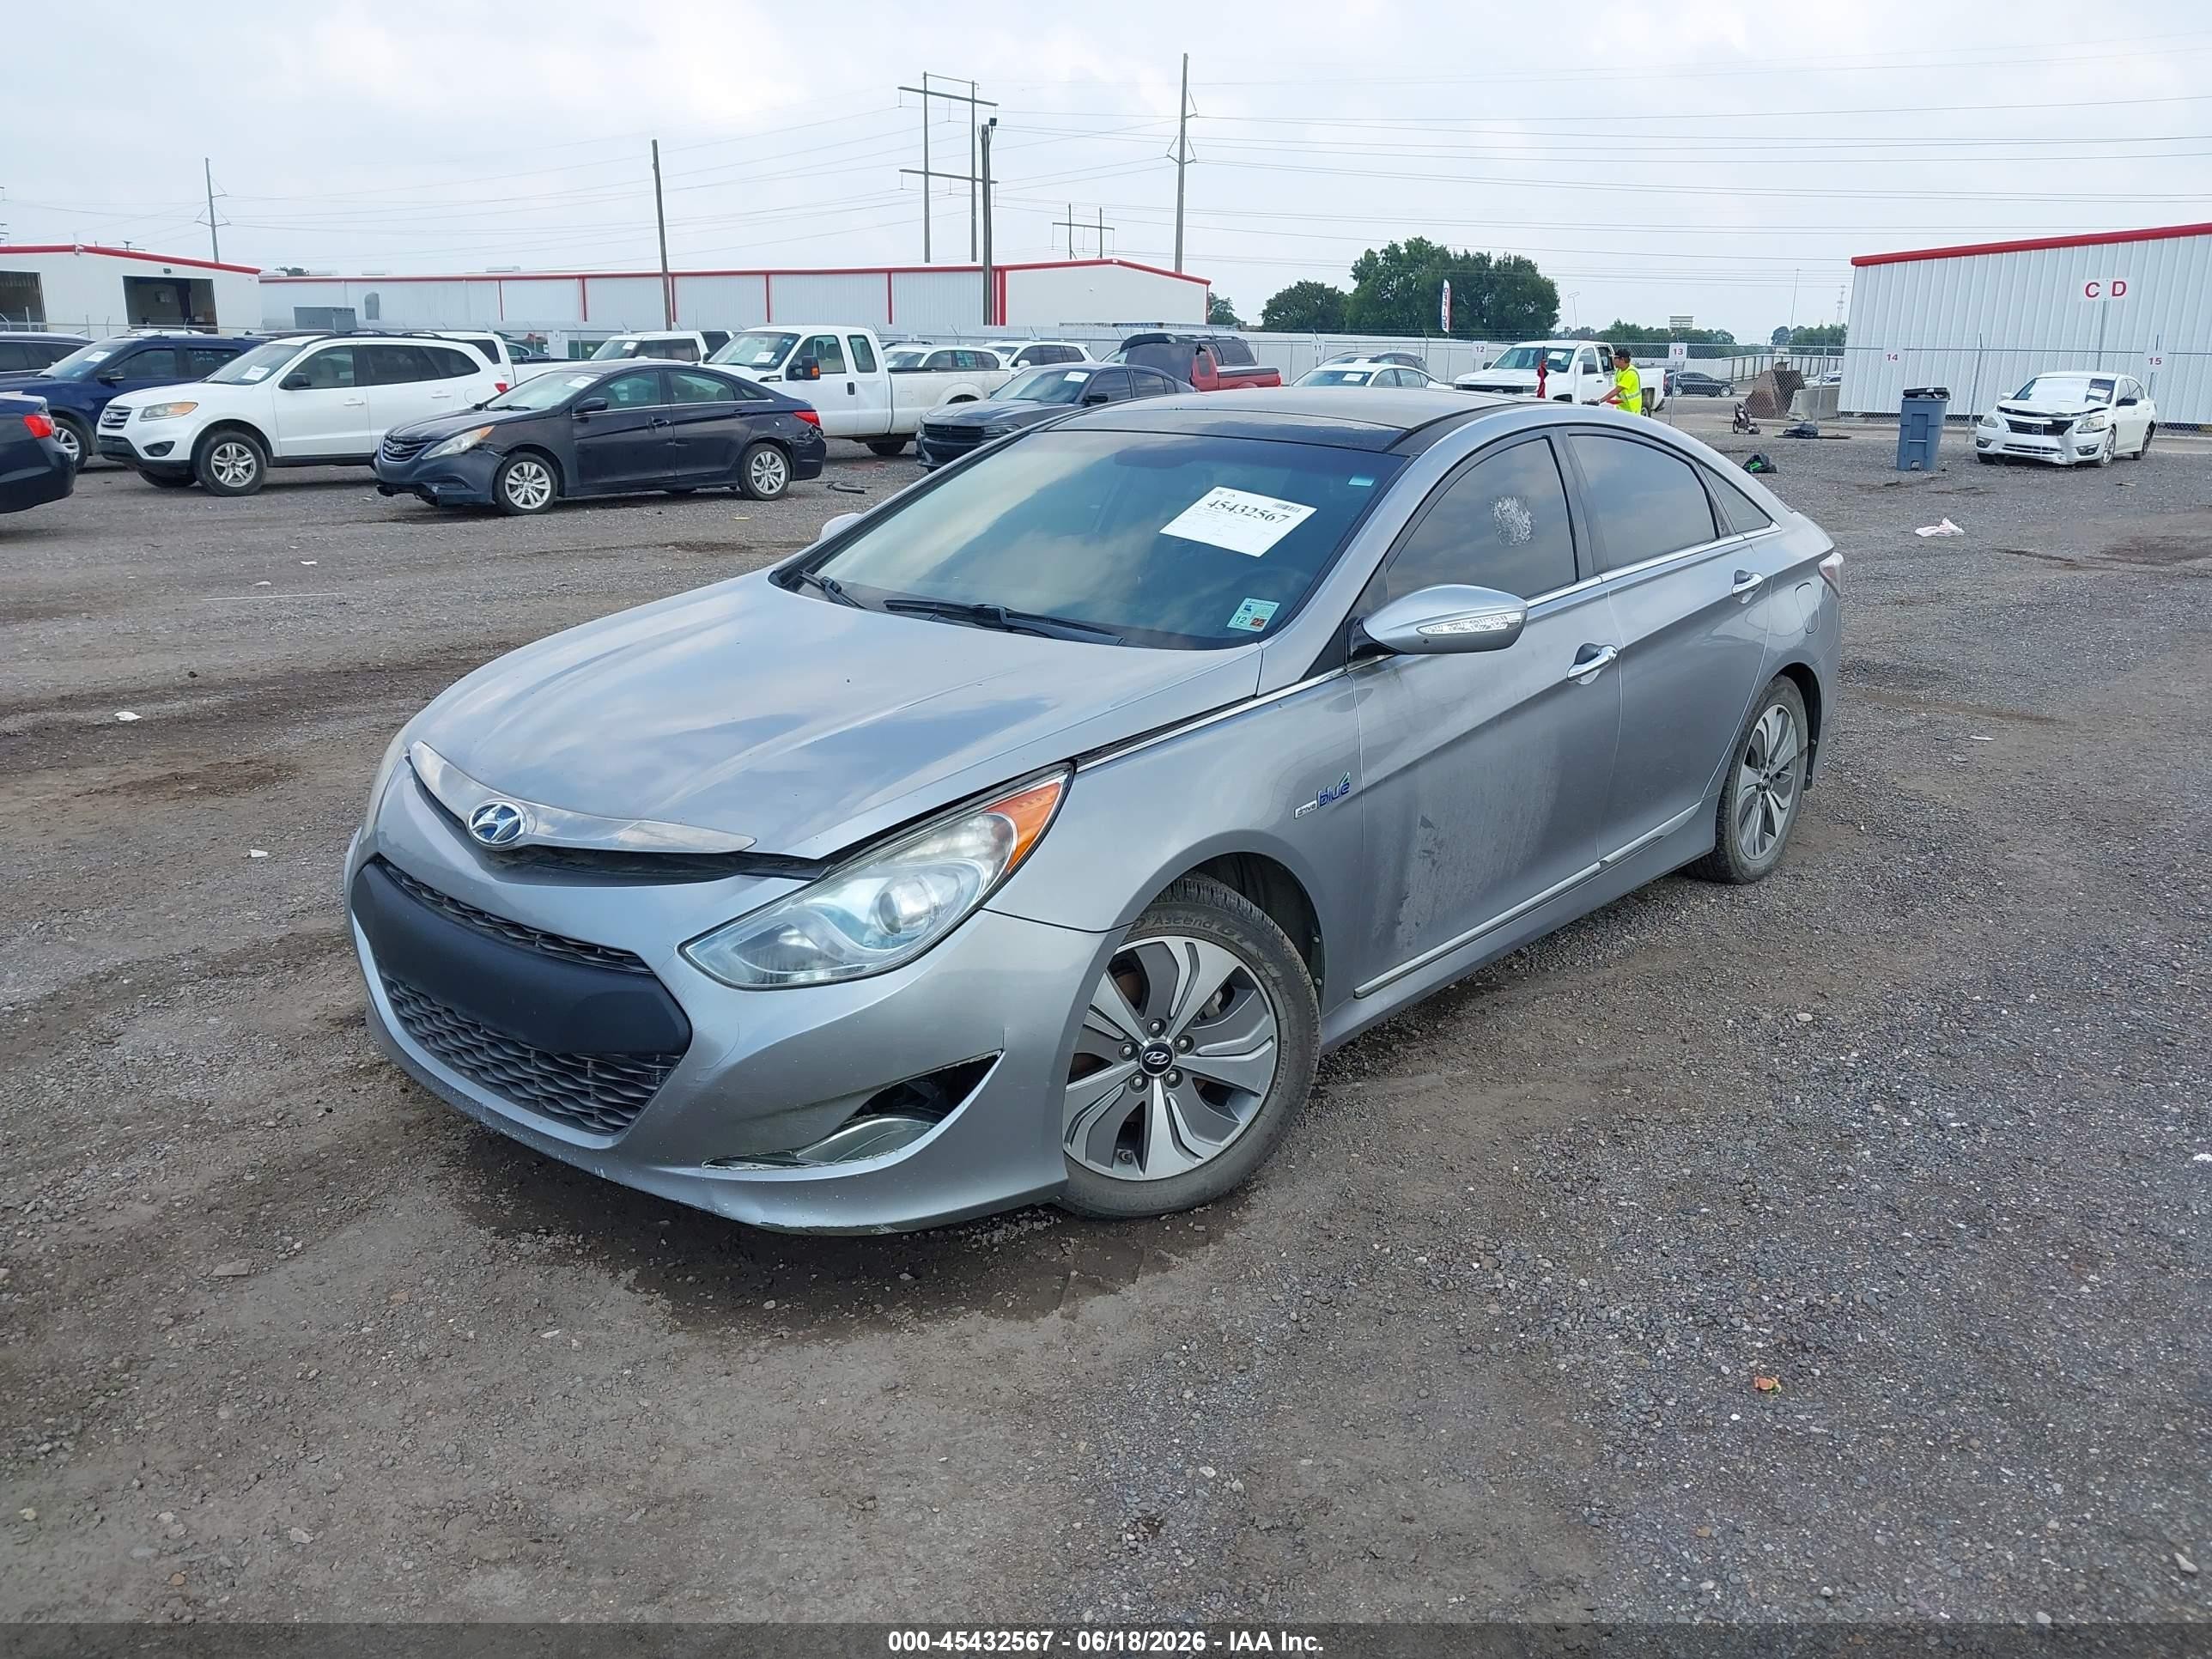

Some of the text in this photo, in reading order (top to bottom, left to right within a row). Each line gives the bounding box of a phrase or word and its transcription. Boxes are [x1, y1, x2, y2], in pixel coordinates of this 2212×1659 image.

[2085, 281, 2127, 298] C D
[1887, 353, 1898, 362] 14
[2148, 356, 2162, 365] 15
[1206, 499, 1291, 525] 45432567
[1235, 616, 1248, 624] 12
[1317, 778, 1350, 808] blue
